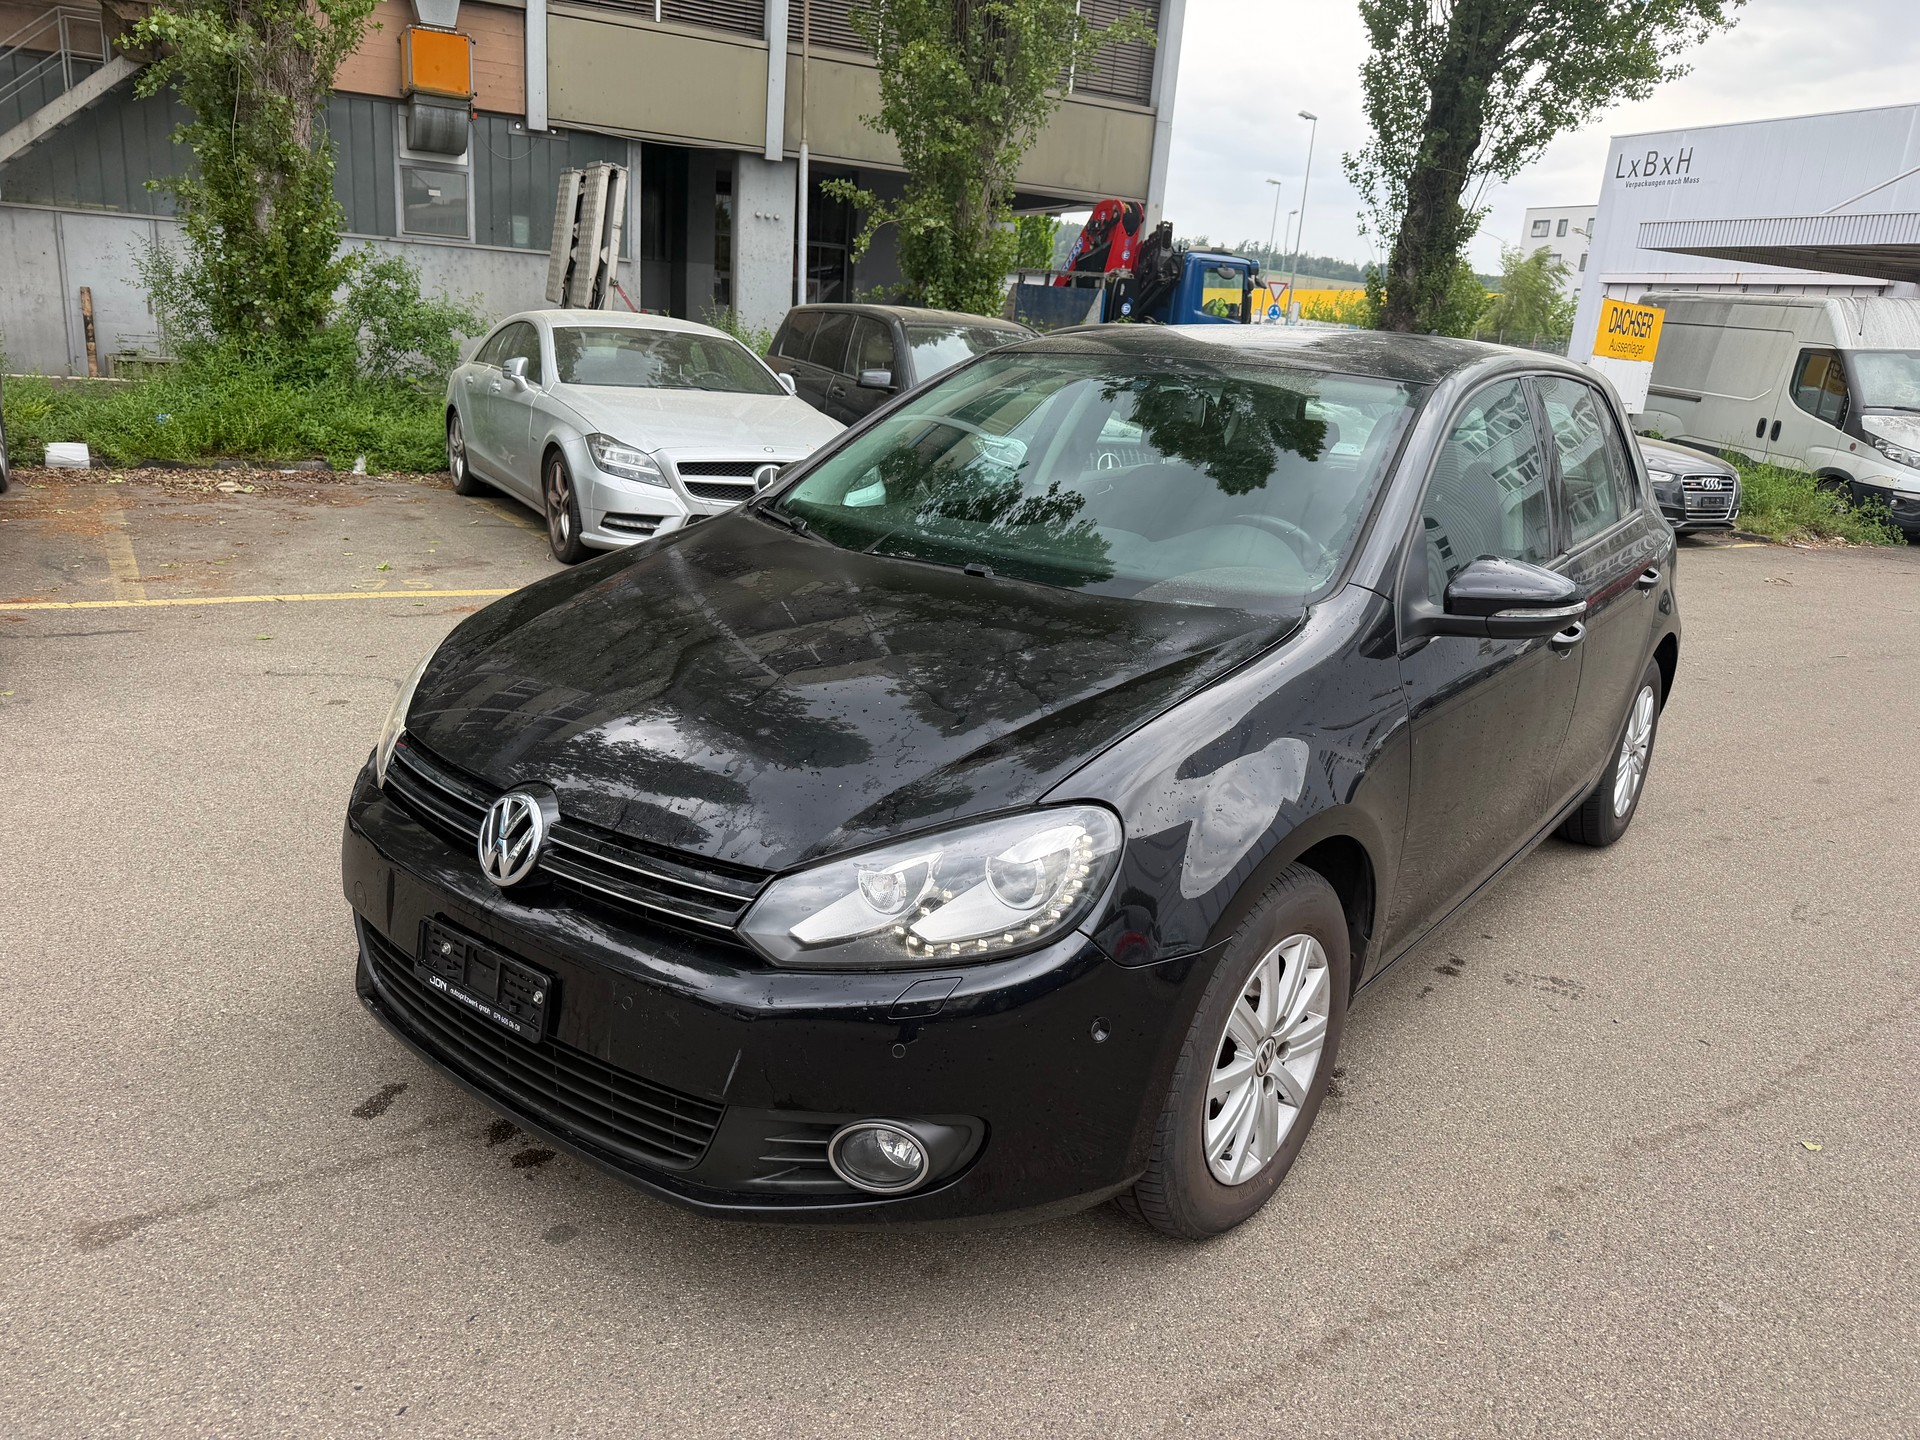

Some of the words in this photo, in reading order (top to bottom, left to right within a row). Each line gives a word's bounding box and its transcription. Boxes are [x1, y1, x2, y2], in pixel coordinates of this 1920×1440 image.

[1625, 180, 1666, 189] Verpackungen
[1667, 178, 1682, 186] nach
[1683, 176, 1700, 184] Mass
[1608, 307, 1654, 338] DACHSER
[1609, 339, 1645, 357] Aussenlager
